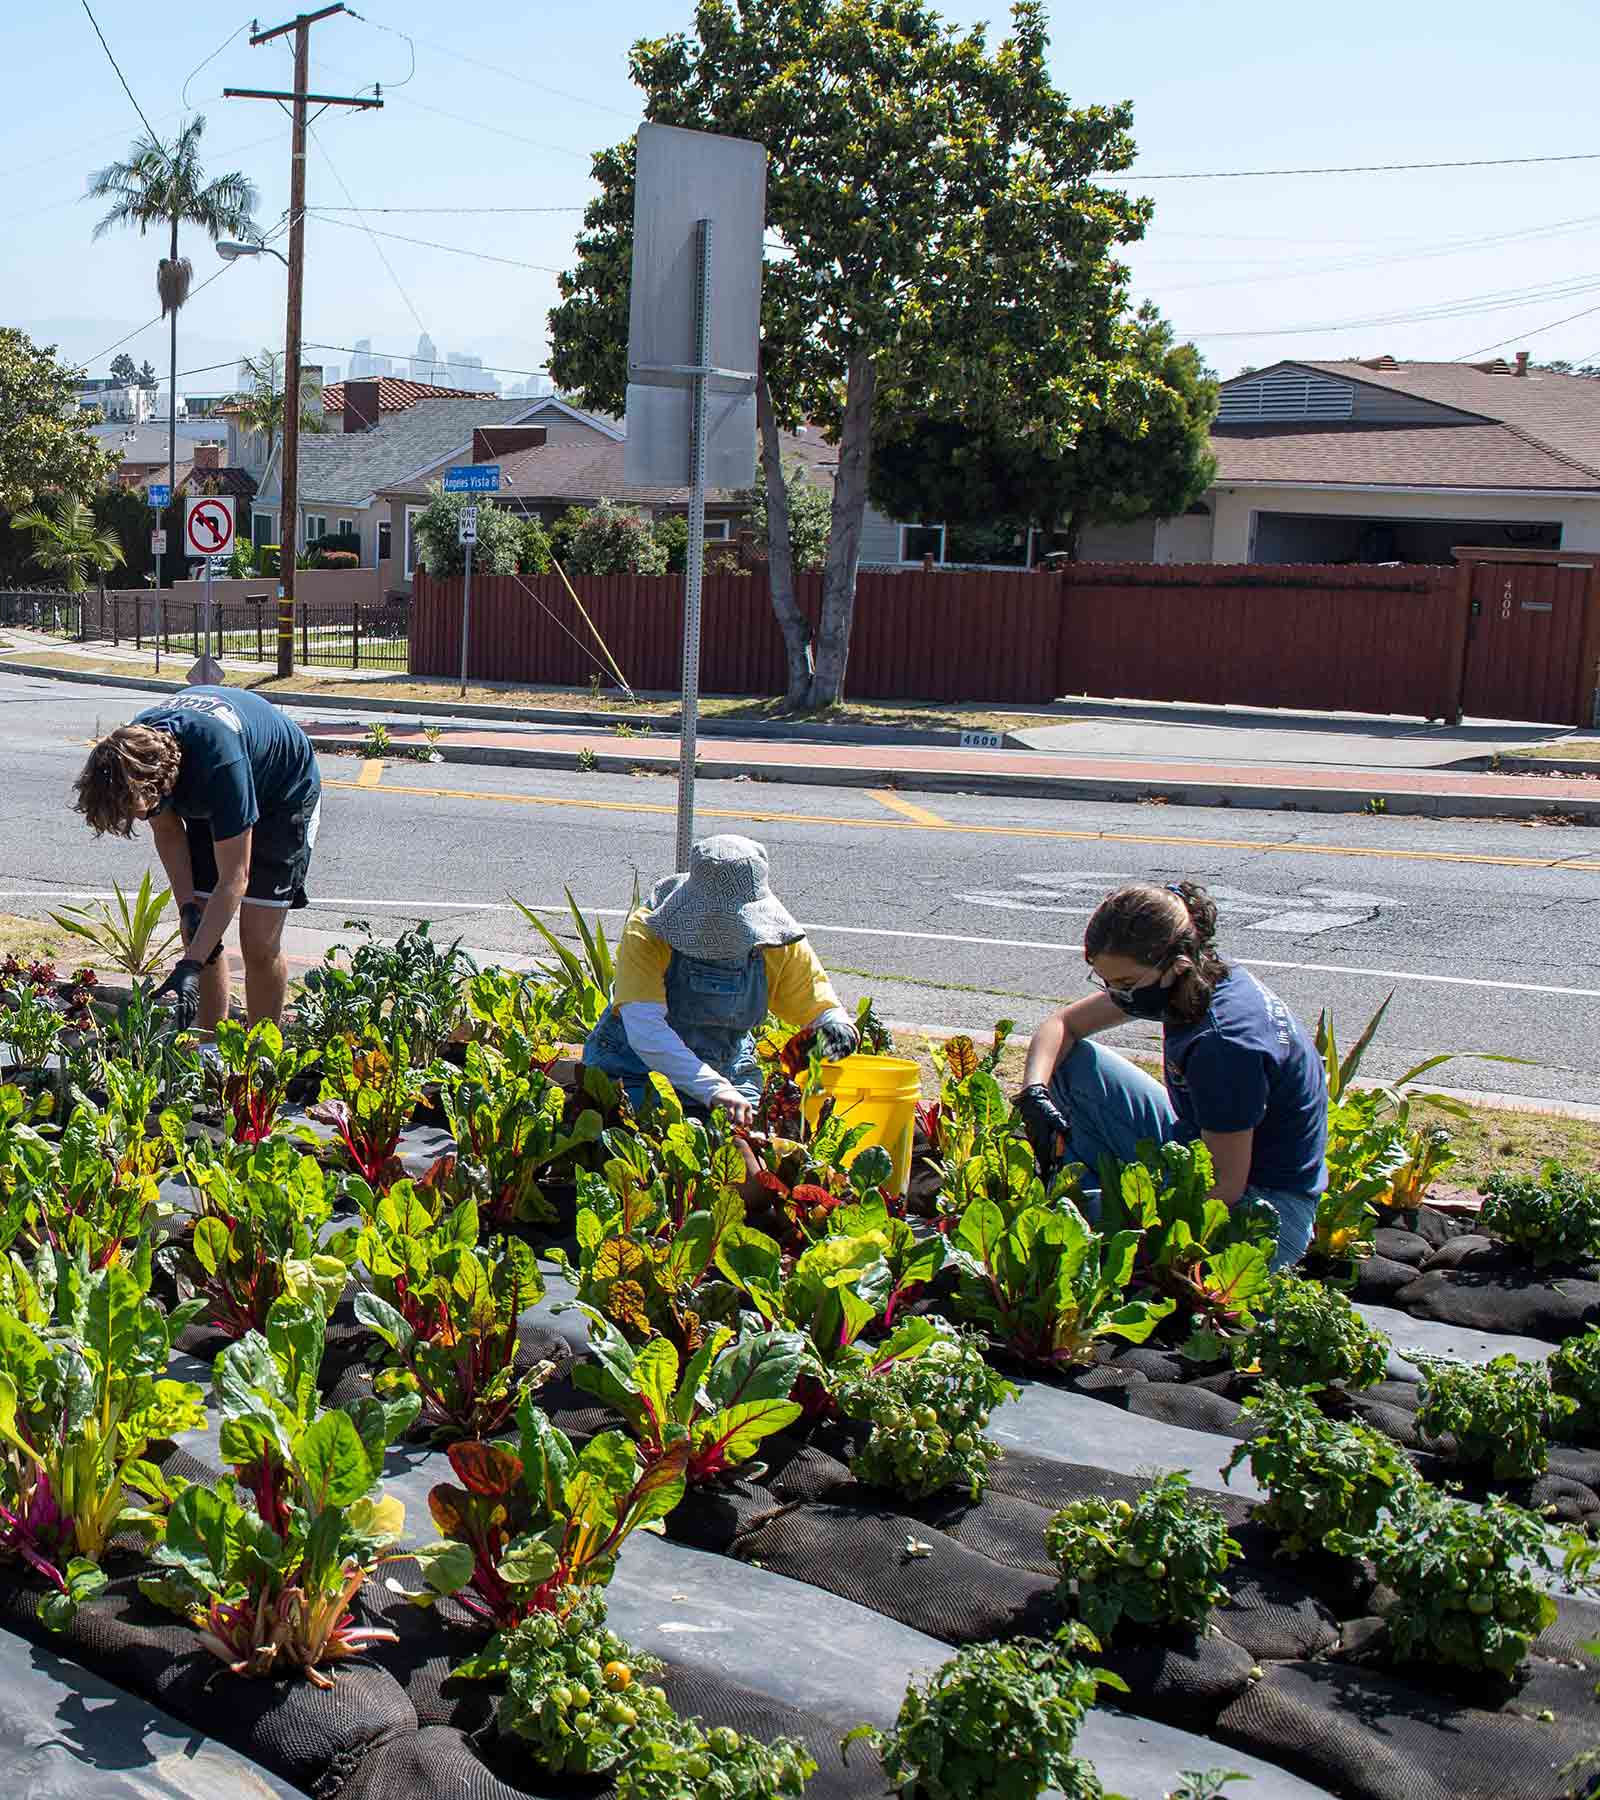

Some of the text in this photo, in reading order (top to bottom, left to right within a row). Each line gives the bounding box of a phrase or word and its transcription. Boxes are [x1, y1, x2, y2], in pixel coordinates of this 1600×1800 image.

[470, 475, 490, 488] Vista
[461, 508, 476, 519] ONE
[462, 520, 476, 529] WAY
[1502, 579, 1511, 618] 4600
[964, 735, 997, 746] 4600
